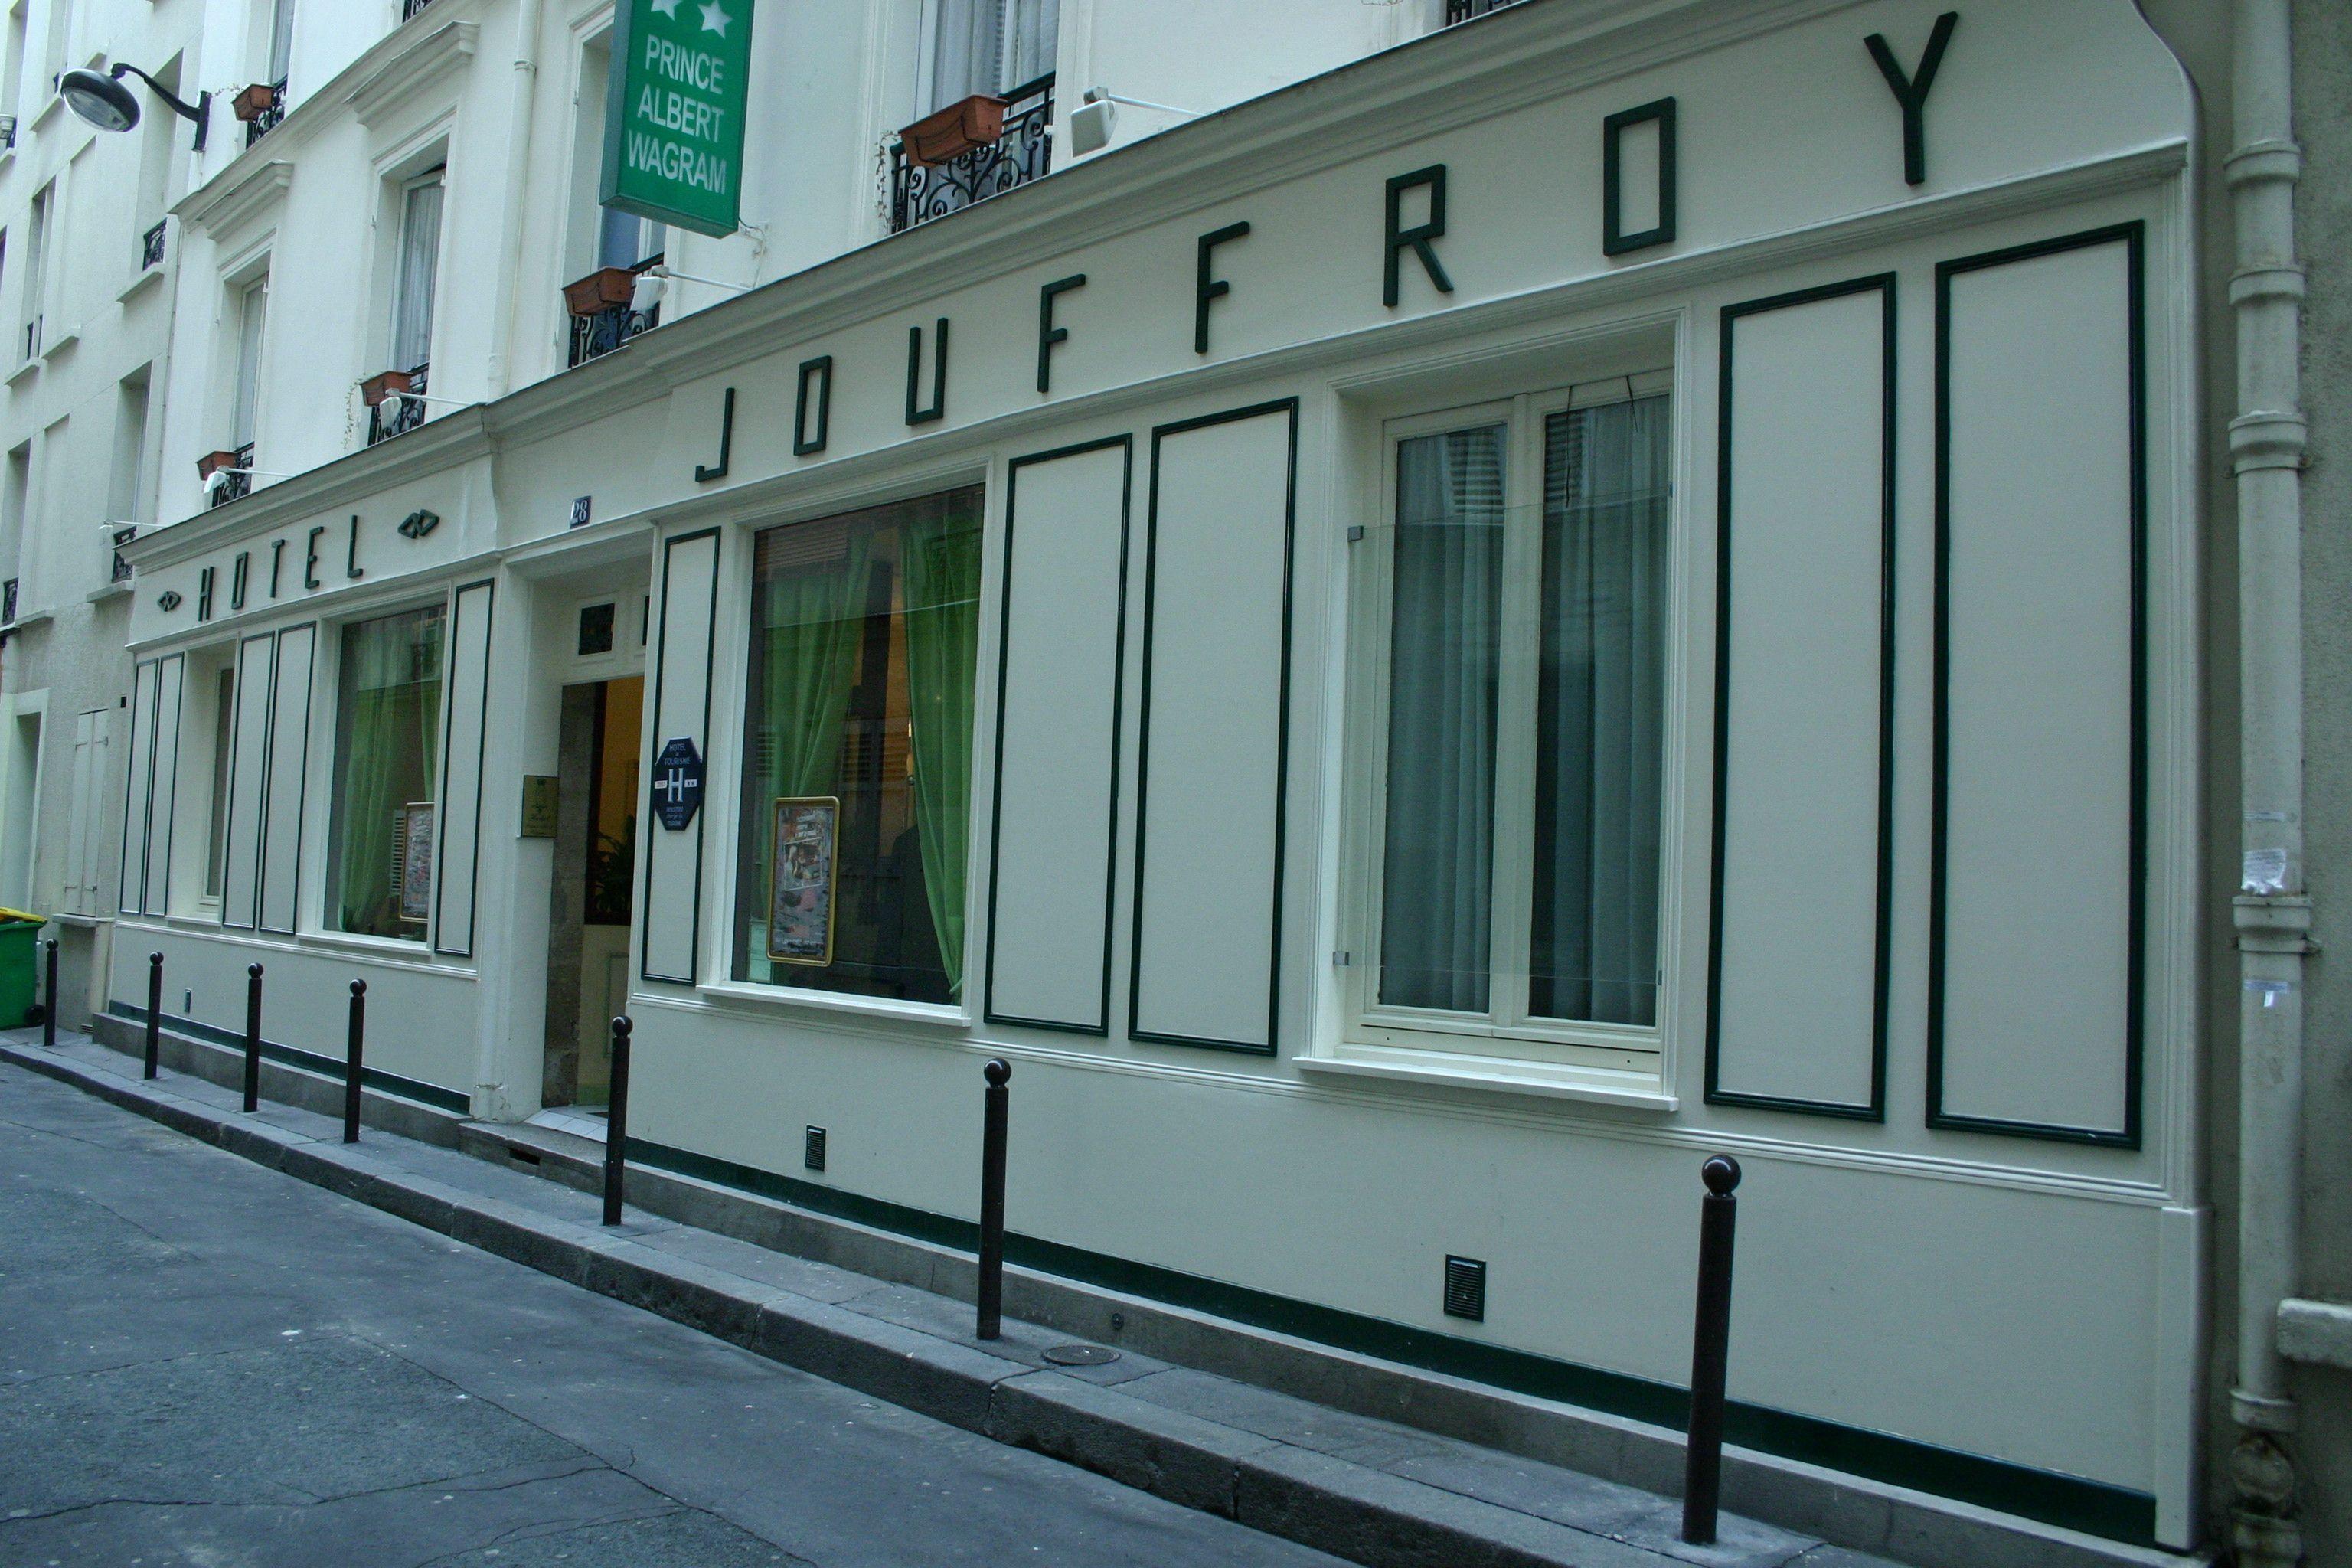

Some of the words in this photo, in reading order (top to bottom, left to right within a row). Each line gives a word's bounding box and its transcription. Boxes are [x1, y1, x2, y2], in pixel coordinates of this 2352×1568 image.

[646, 34, 724, 94] PRINCE
[637, 84, 724, 142] ALBERT
[629, 130, 727, 194] WAGRAM
[694, 11, 1959, 483] JOUFFROY
[570, 500, 587, 521] 28
[198, 514, 363, 622] HOTEL
[669, 743, 686, 751] HOTEL
[668, 767, 684, 803] H
